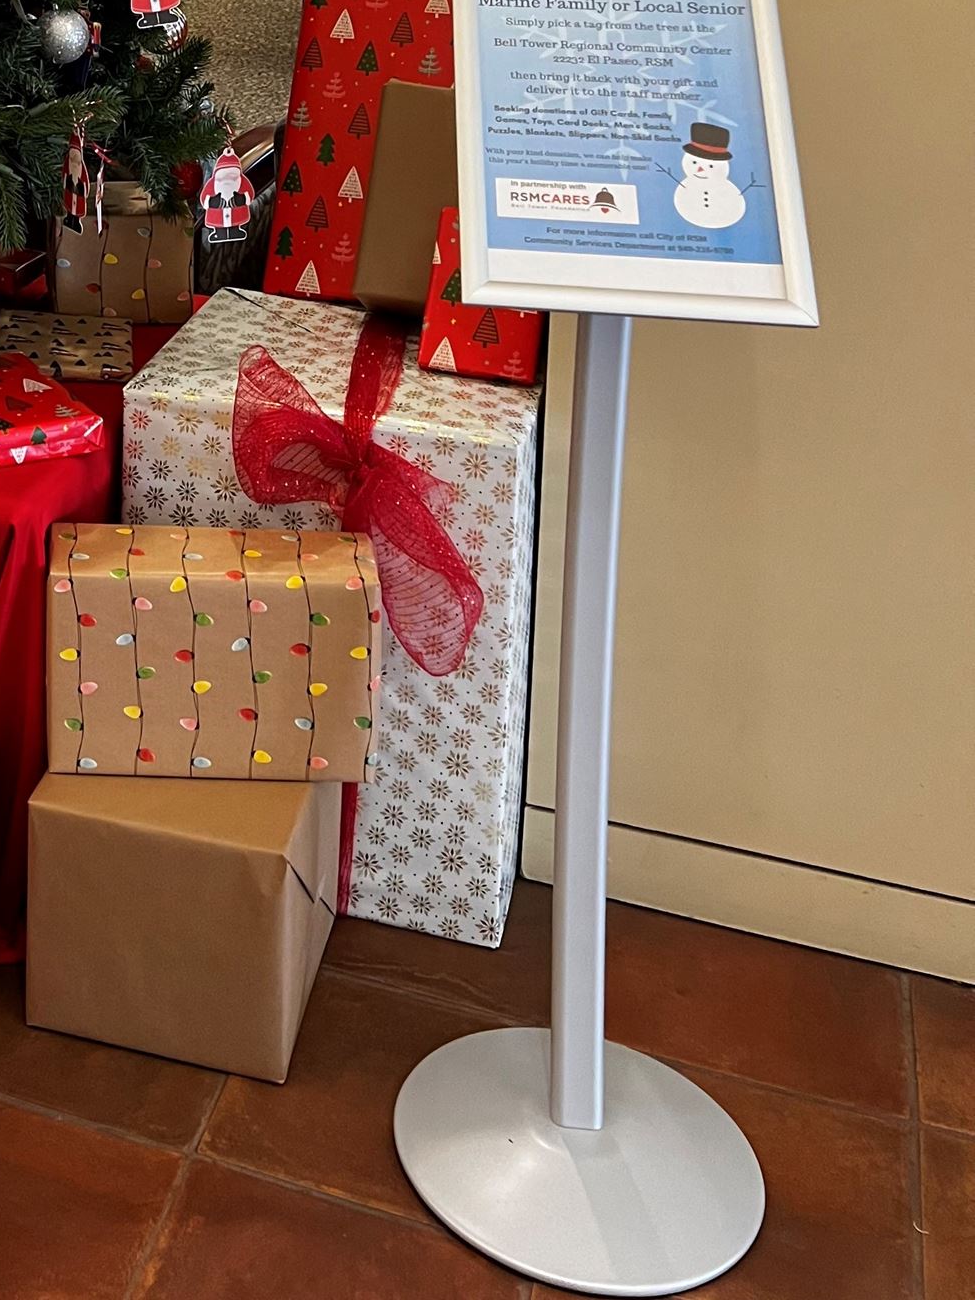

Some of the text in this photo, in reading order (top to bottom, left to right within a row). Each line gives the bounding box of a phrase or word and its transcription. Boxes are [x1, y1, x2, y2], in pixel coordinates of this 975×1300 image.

[612, 1, 630, 12] or
[634, 0, 683, 14] Local
[687, 2, 745, 16] Senior
[505, 17, 545, 28] Simply
[547, 20, 572, 28] pick
[583, 21, 603, 31] tag
[605, 21, 632, 30] from
[634, 22, 654, 31] the
[656, 24, 680, 32] tree
[696, 25, 715, 33] the
[494, 38, 732, 56] Bell Tower Regional Community Center
[553, 55, 674, 67] 22232 El Paseo, RSM
[510, 70, 719, 89] then bring it back with your gift and
[525, 84, 705, 102] deliver it to the staff member.
[494, 105, 530, 115] Seeking
[532, 106, 577, 115] donations
[590, 109, 608, 117] Gift
[610, 110, 641, 118] Cards,
[642, 111, 672, 121] Family
[495, 115, 673, 132] Games, Toys, Card Decks, Men's Socks,
[487, 126, 682, 143] Puzzles, Blankets, Slippers, Non-Skid Socks
[485, 147, 505, 155] With
[520, 181, 568, 191] partnership
[510, 191, 590, 205] RSMCARES
[546, 226, 561, 234] For
[563, 228, 586, 236] more
[524, 236, 573, 247] Community
